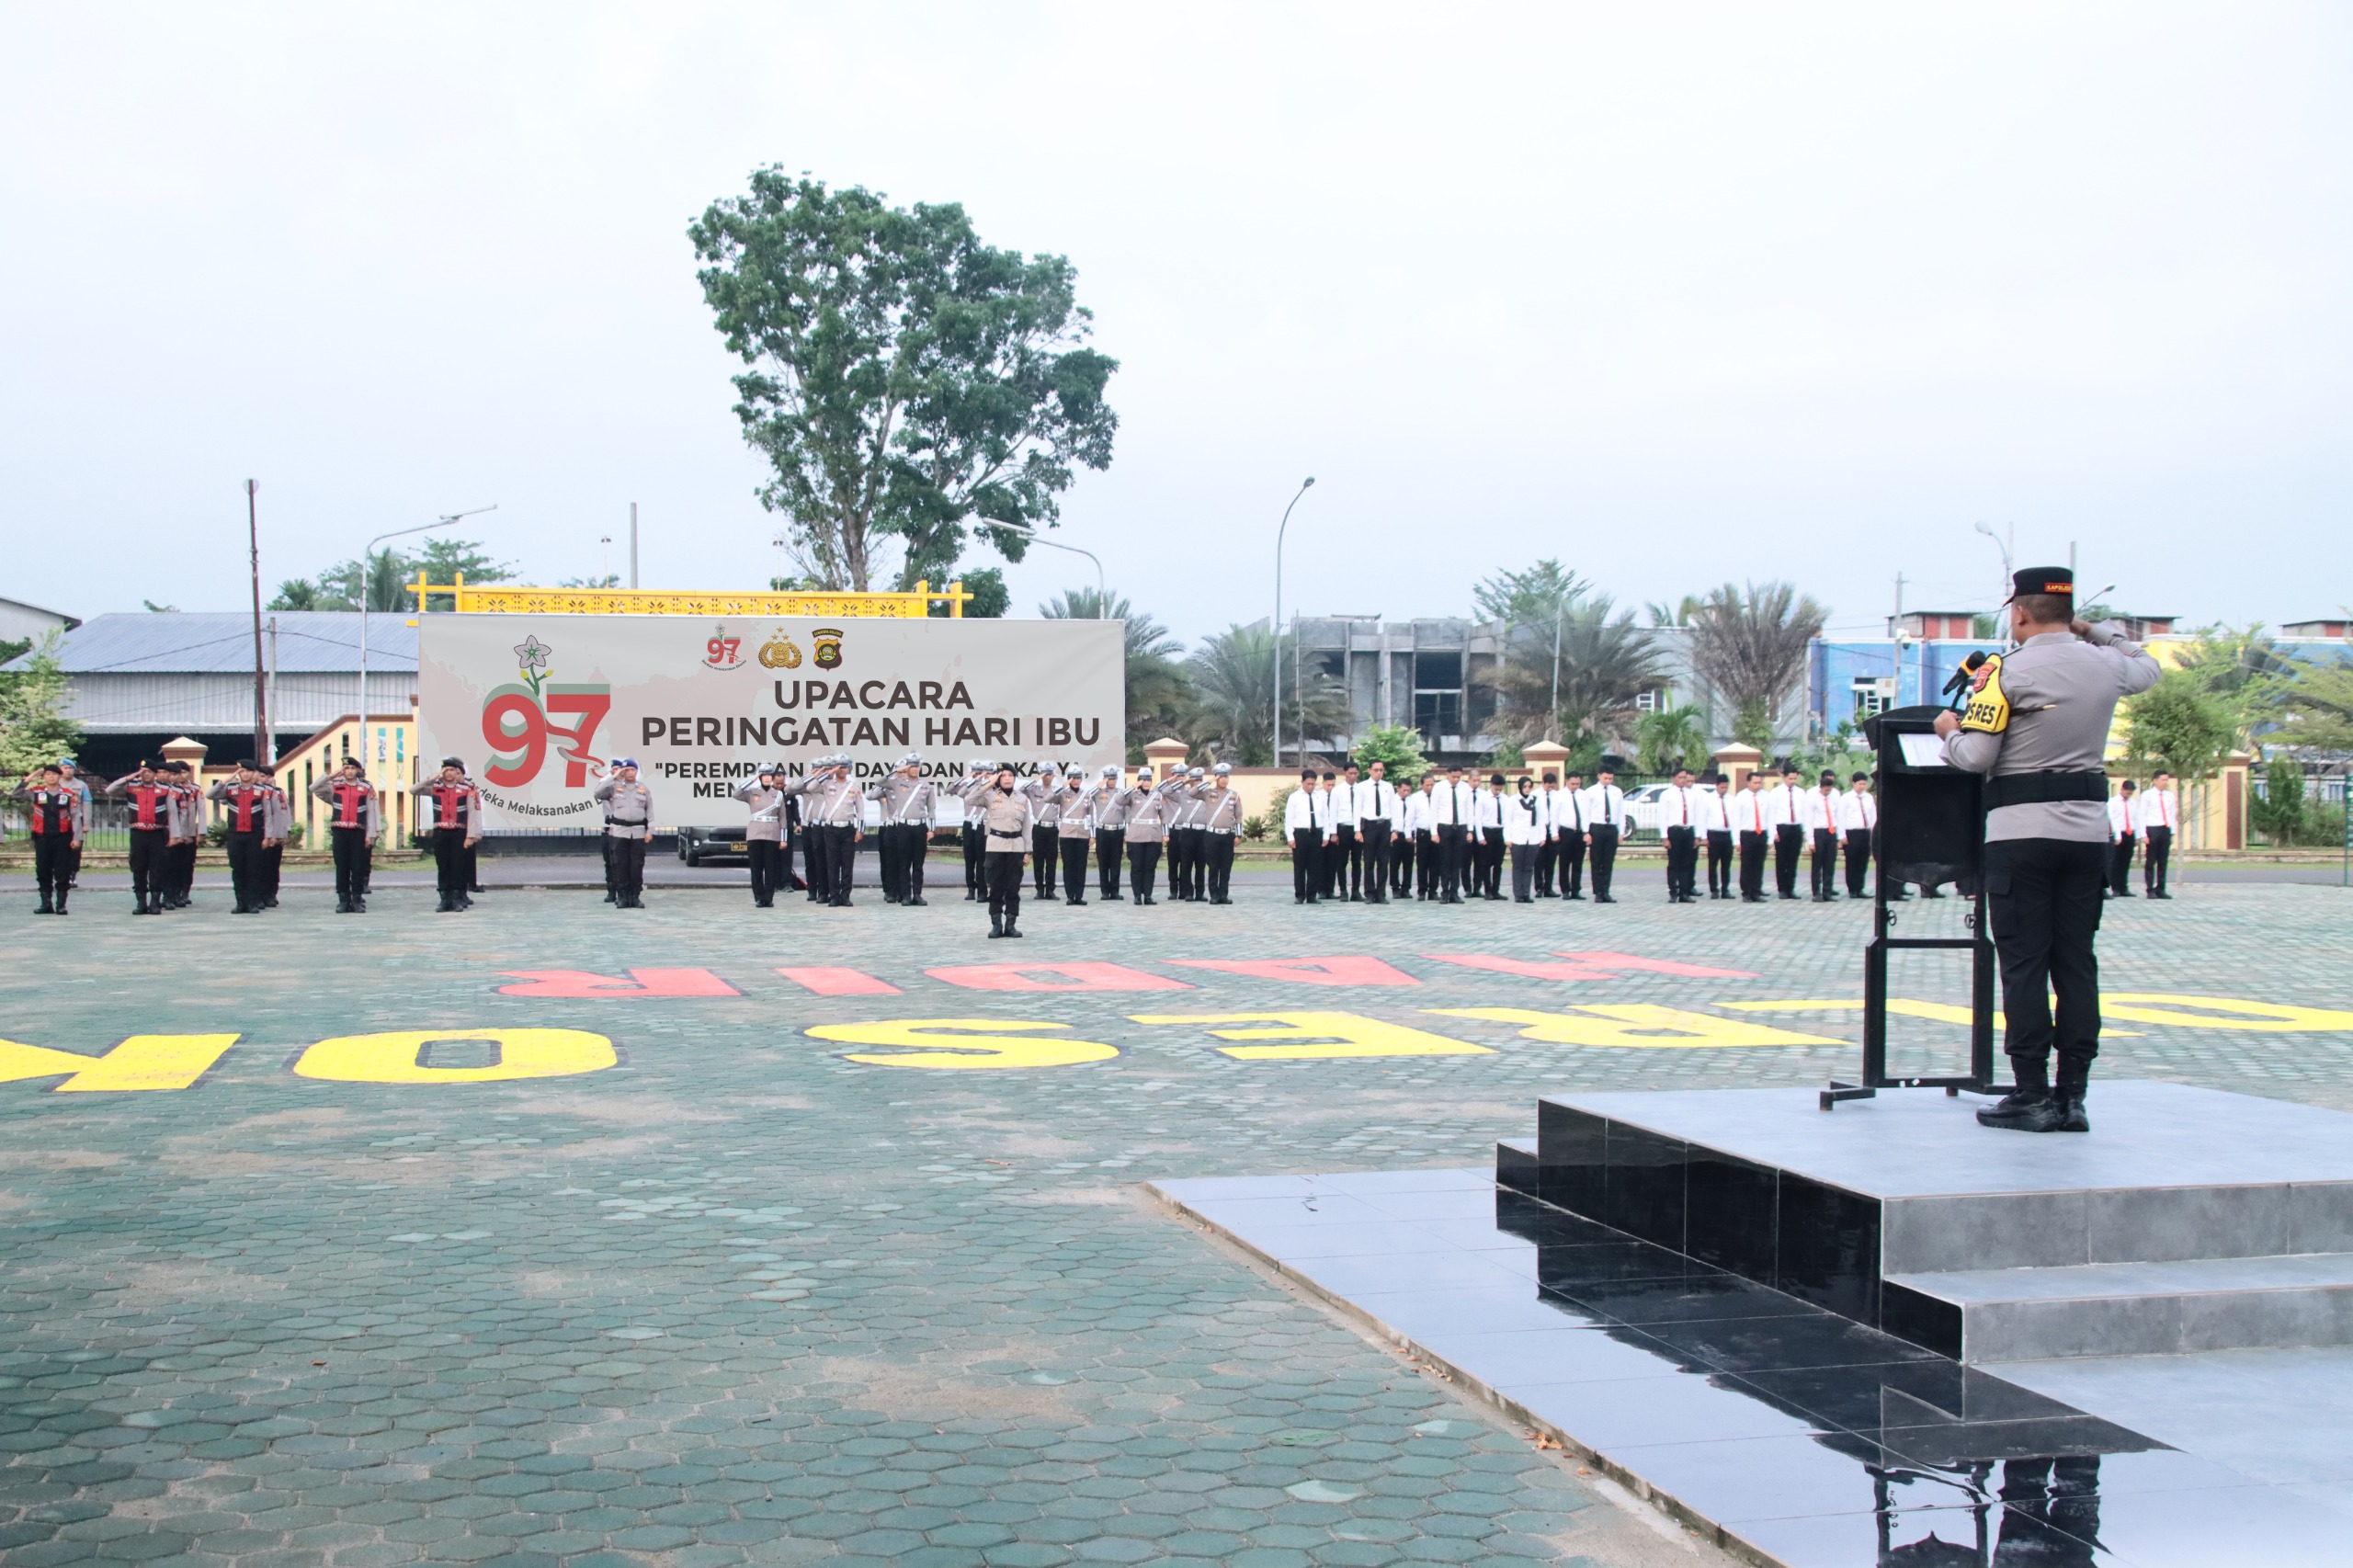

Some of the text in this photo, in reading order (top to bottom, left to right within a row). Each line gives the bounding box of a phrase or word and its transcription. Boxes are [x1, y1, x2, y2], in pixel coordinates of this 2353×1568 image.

[707, 637, 741, 665] 97
[775, 681, 973, 710] UPACARA
[482, 684, 610, 788] 97
[642, 717, 1099, 746] PERINGATAN HARI IBU
[655, 762, 804, 778] "PEREMPAN
[919, 762, 964, 778] DAN
[507, 799, 594, 816] Melaksanakan
[497, 951, 1761, 997] HADIR
